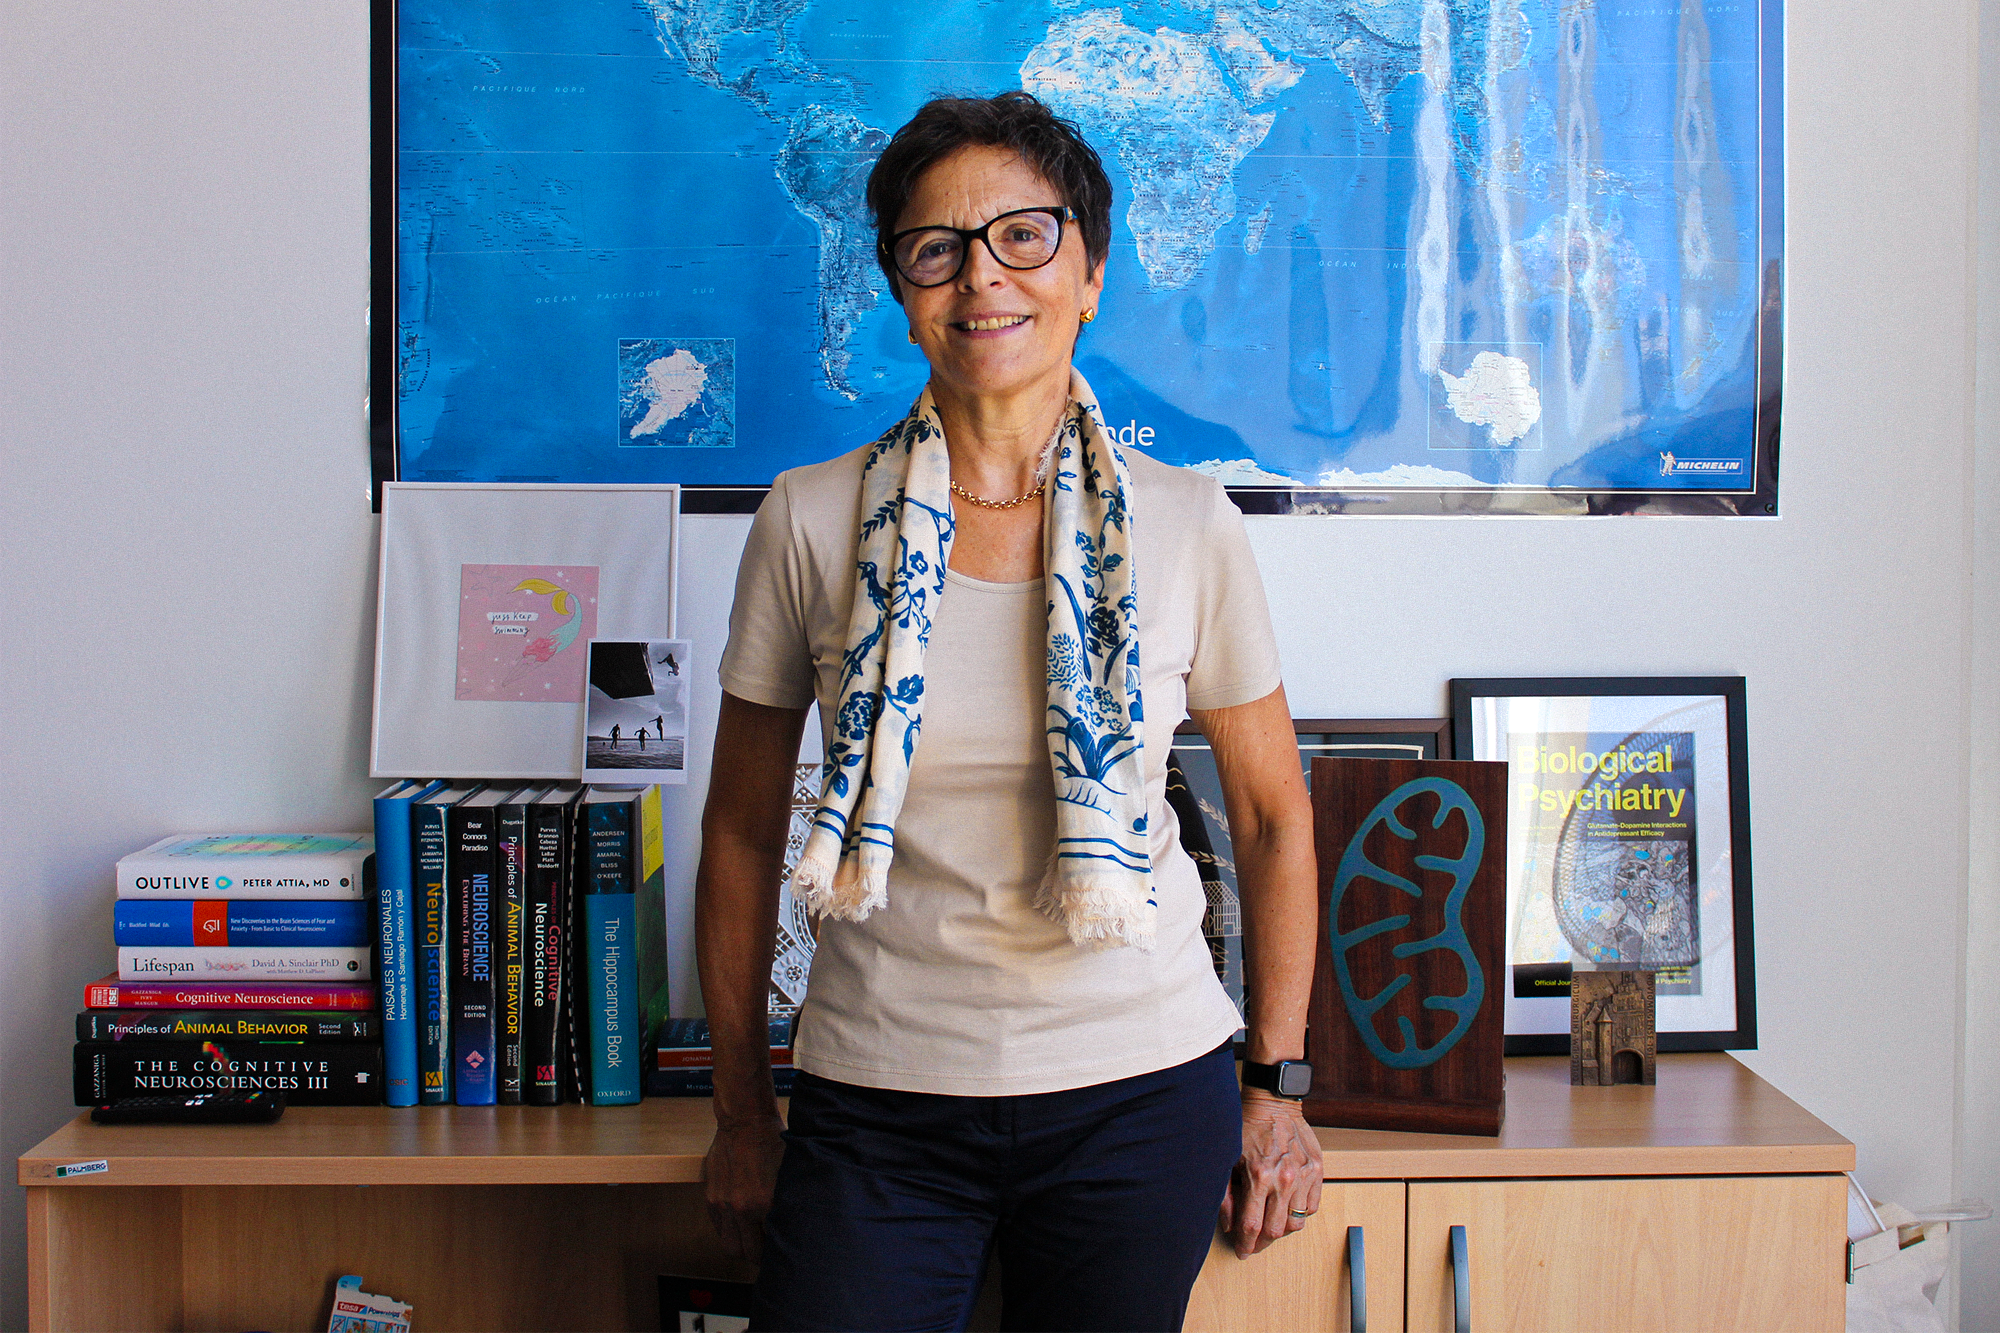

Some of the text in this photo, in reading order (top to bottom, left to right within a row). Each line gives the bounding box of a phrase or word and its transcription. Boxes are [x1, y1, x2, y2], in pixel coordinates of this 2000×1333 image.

[596, 290, 661, 300] PACIFIQUE
[1106, 419, 1156, 446] nde
[1677, 461, 1740, 470] MICHELIN
[1517, 745, 1673, 781] Biological
[1518, 782, 1686, 818] Psychiatry
[1587, 822, 1650, 830] Glutamate-Dopamine
[135, 876, 210, 889] OUTLIVE
[243, 879, 330, 888] PETER ATTIA, MD
[396, 889, 404, 907] Cajal
[472, 873, 489, 982] NEUROSCIENCE
[506, 836, 521, 1034] Principles of ANIMAL BEHAVIOR
[381, 889, 395, 1021] PAISAJES NEURONALES
[397, 943, 407, 975] Santiago
[534, 902, 547, 1007] Neuroscience
[133, 957, 195, 976] Lifespan
[252, 959, 340, 968] David A. Sinclair PhD
[546, 925, 560, 1001] Cognitive
[108, 989, 118, 1005] ISE
[176, 992, 231, 1005] Cognitive
[234, 993, 314, 1004] Neuroscience
[603, 917, 623, 1069] The Hippocampus Book
[1572, 975, 1580, 1034] CHIRURGICUM
[108, 1020, 308, 1035] Principles of ANIMAL BEHAVIOR
[134, 1060, 328, 1072] THE COGNITIVE
[134, 1076, 328, 1089] NEUROSCIENCES III
[597, 1090, 631, 1098] OXFORD
[67, 1163, 106, 1174] PALMBERG
[339, 1302, 360, 1312] tesa
